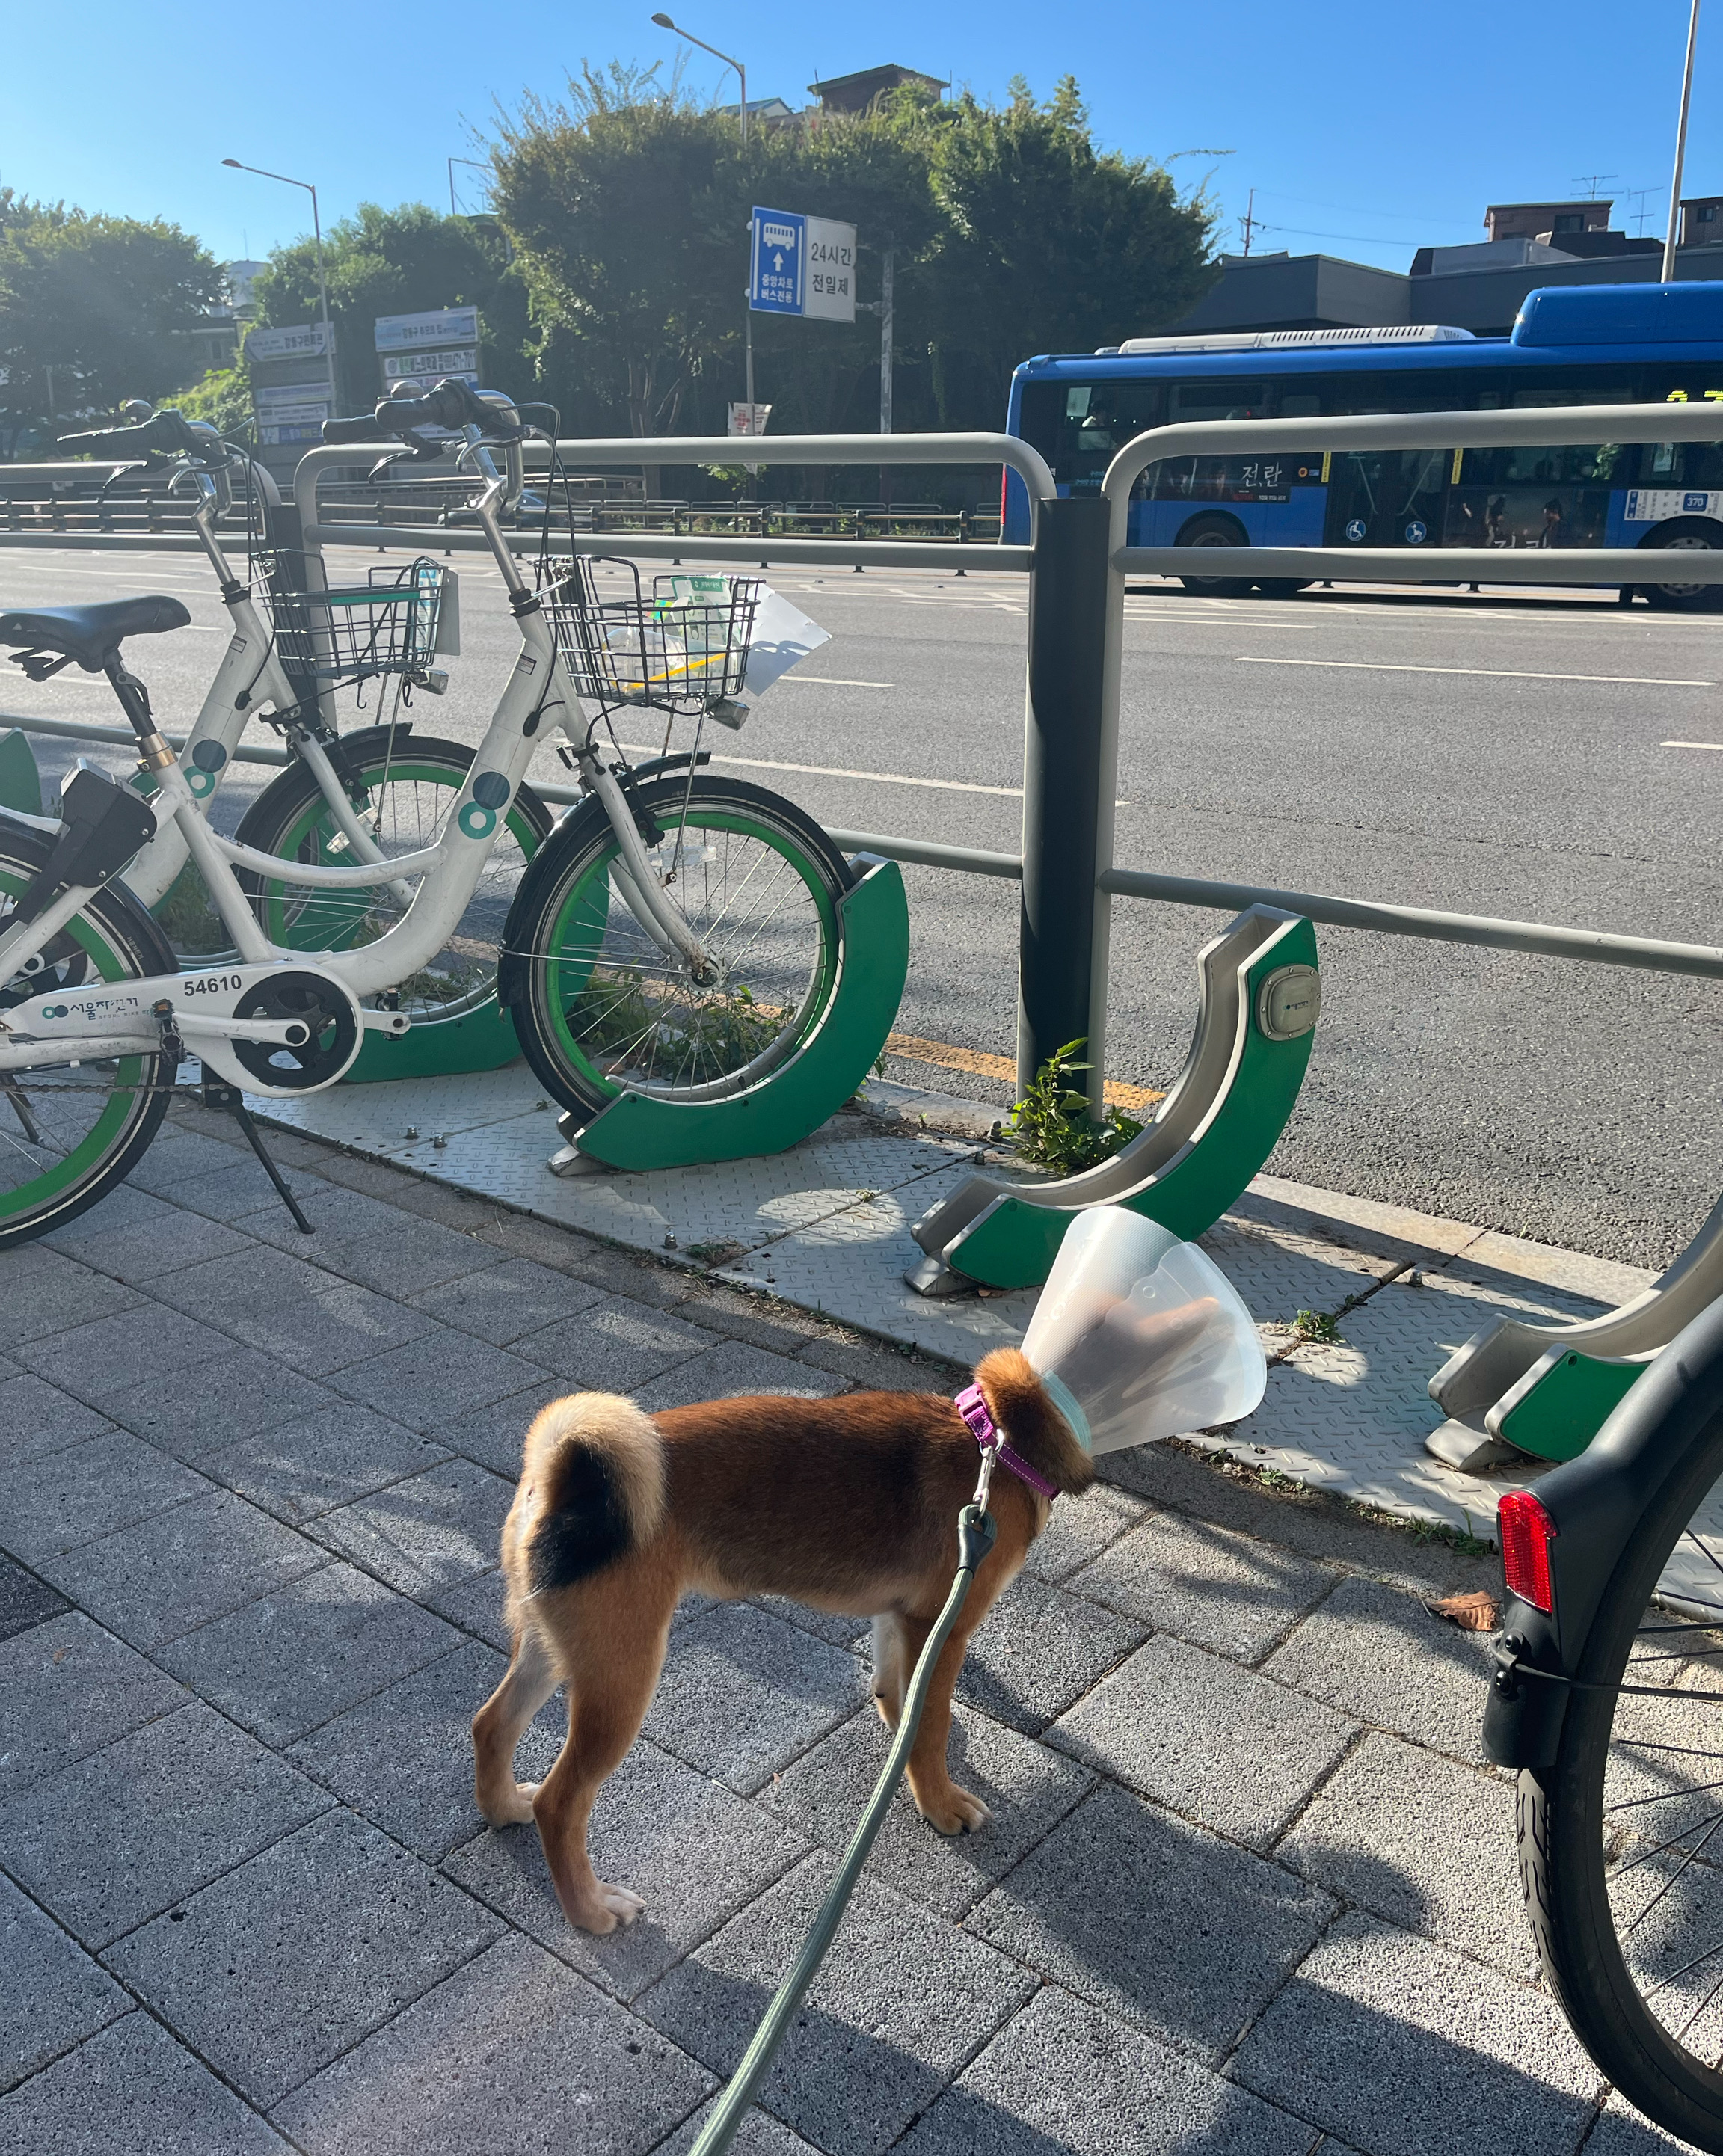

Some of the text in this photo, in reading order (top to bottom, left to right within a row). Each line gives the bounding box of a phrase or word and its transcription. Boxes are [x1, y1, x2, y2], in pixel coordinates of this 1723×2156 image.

[811, 242, 851, 266] 24시간
[762, 274, 793, 289] 중앙차로
[812, 274, 849, 296] 전일제
[761, 289, 793, 304] 버스전용
[1687, 497, 1704, 506] 370
[184, 974, 242, 996] 54610
